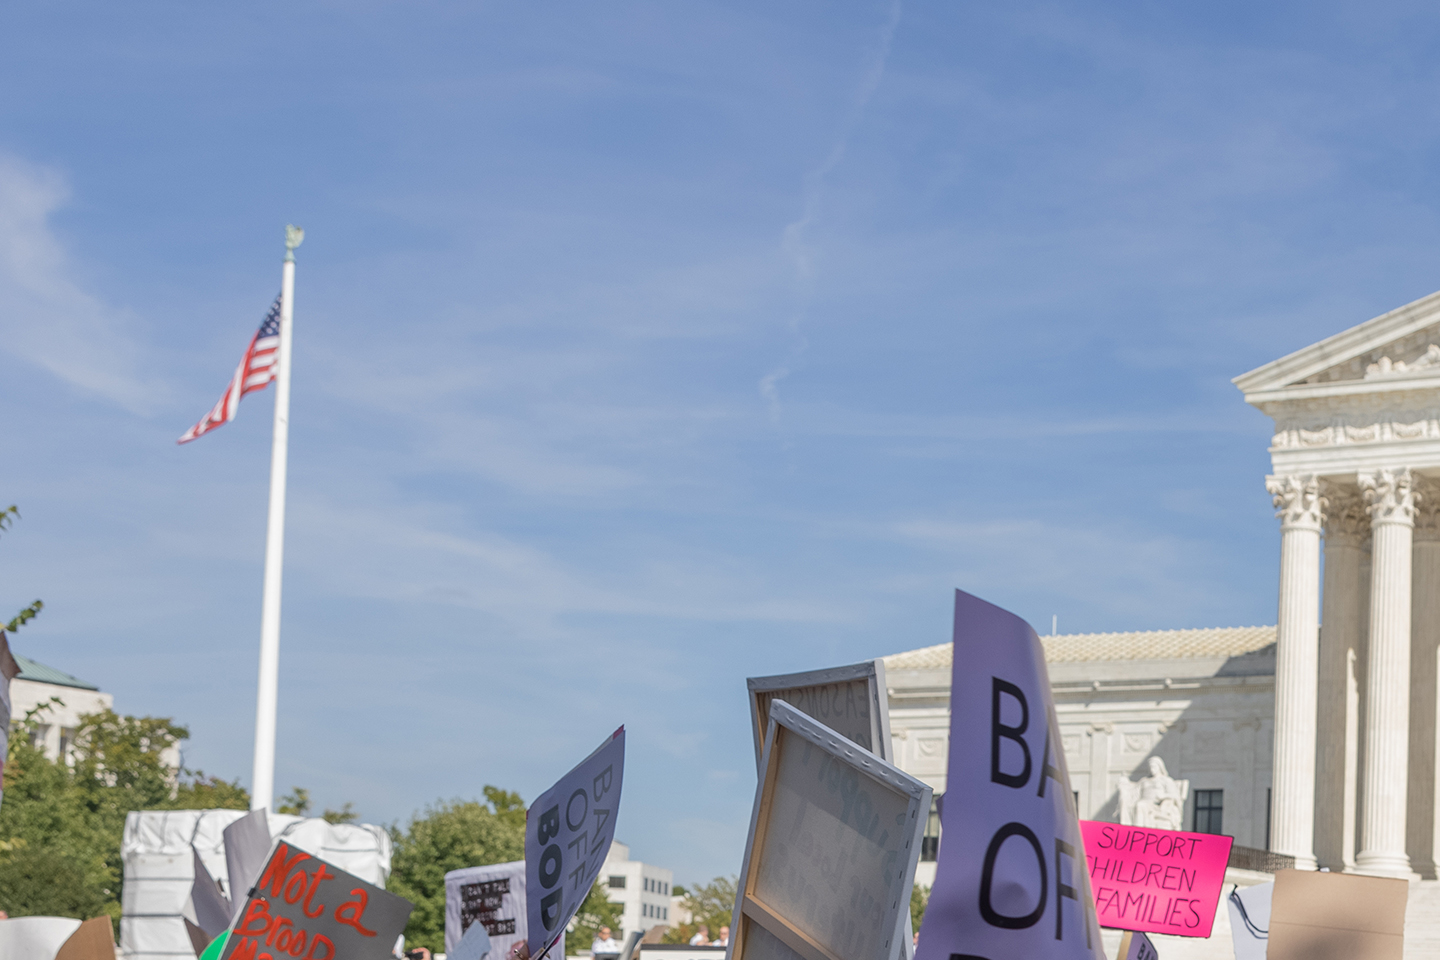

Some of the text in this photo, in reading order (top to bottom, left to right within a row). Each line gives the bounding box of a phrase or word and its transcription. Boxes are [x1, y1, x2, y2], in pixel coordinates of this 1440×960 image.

[565, 787, 588, 891] OFF
[1097, 826, 1203, 860] SUPPORT
[259, 844, 378, 937] Not a
[1086, 855, 1197, 893] HILDREN
[1095, 887, 1201, 929] FAMILIES
